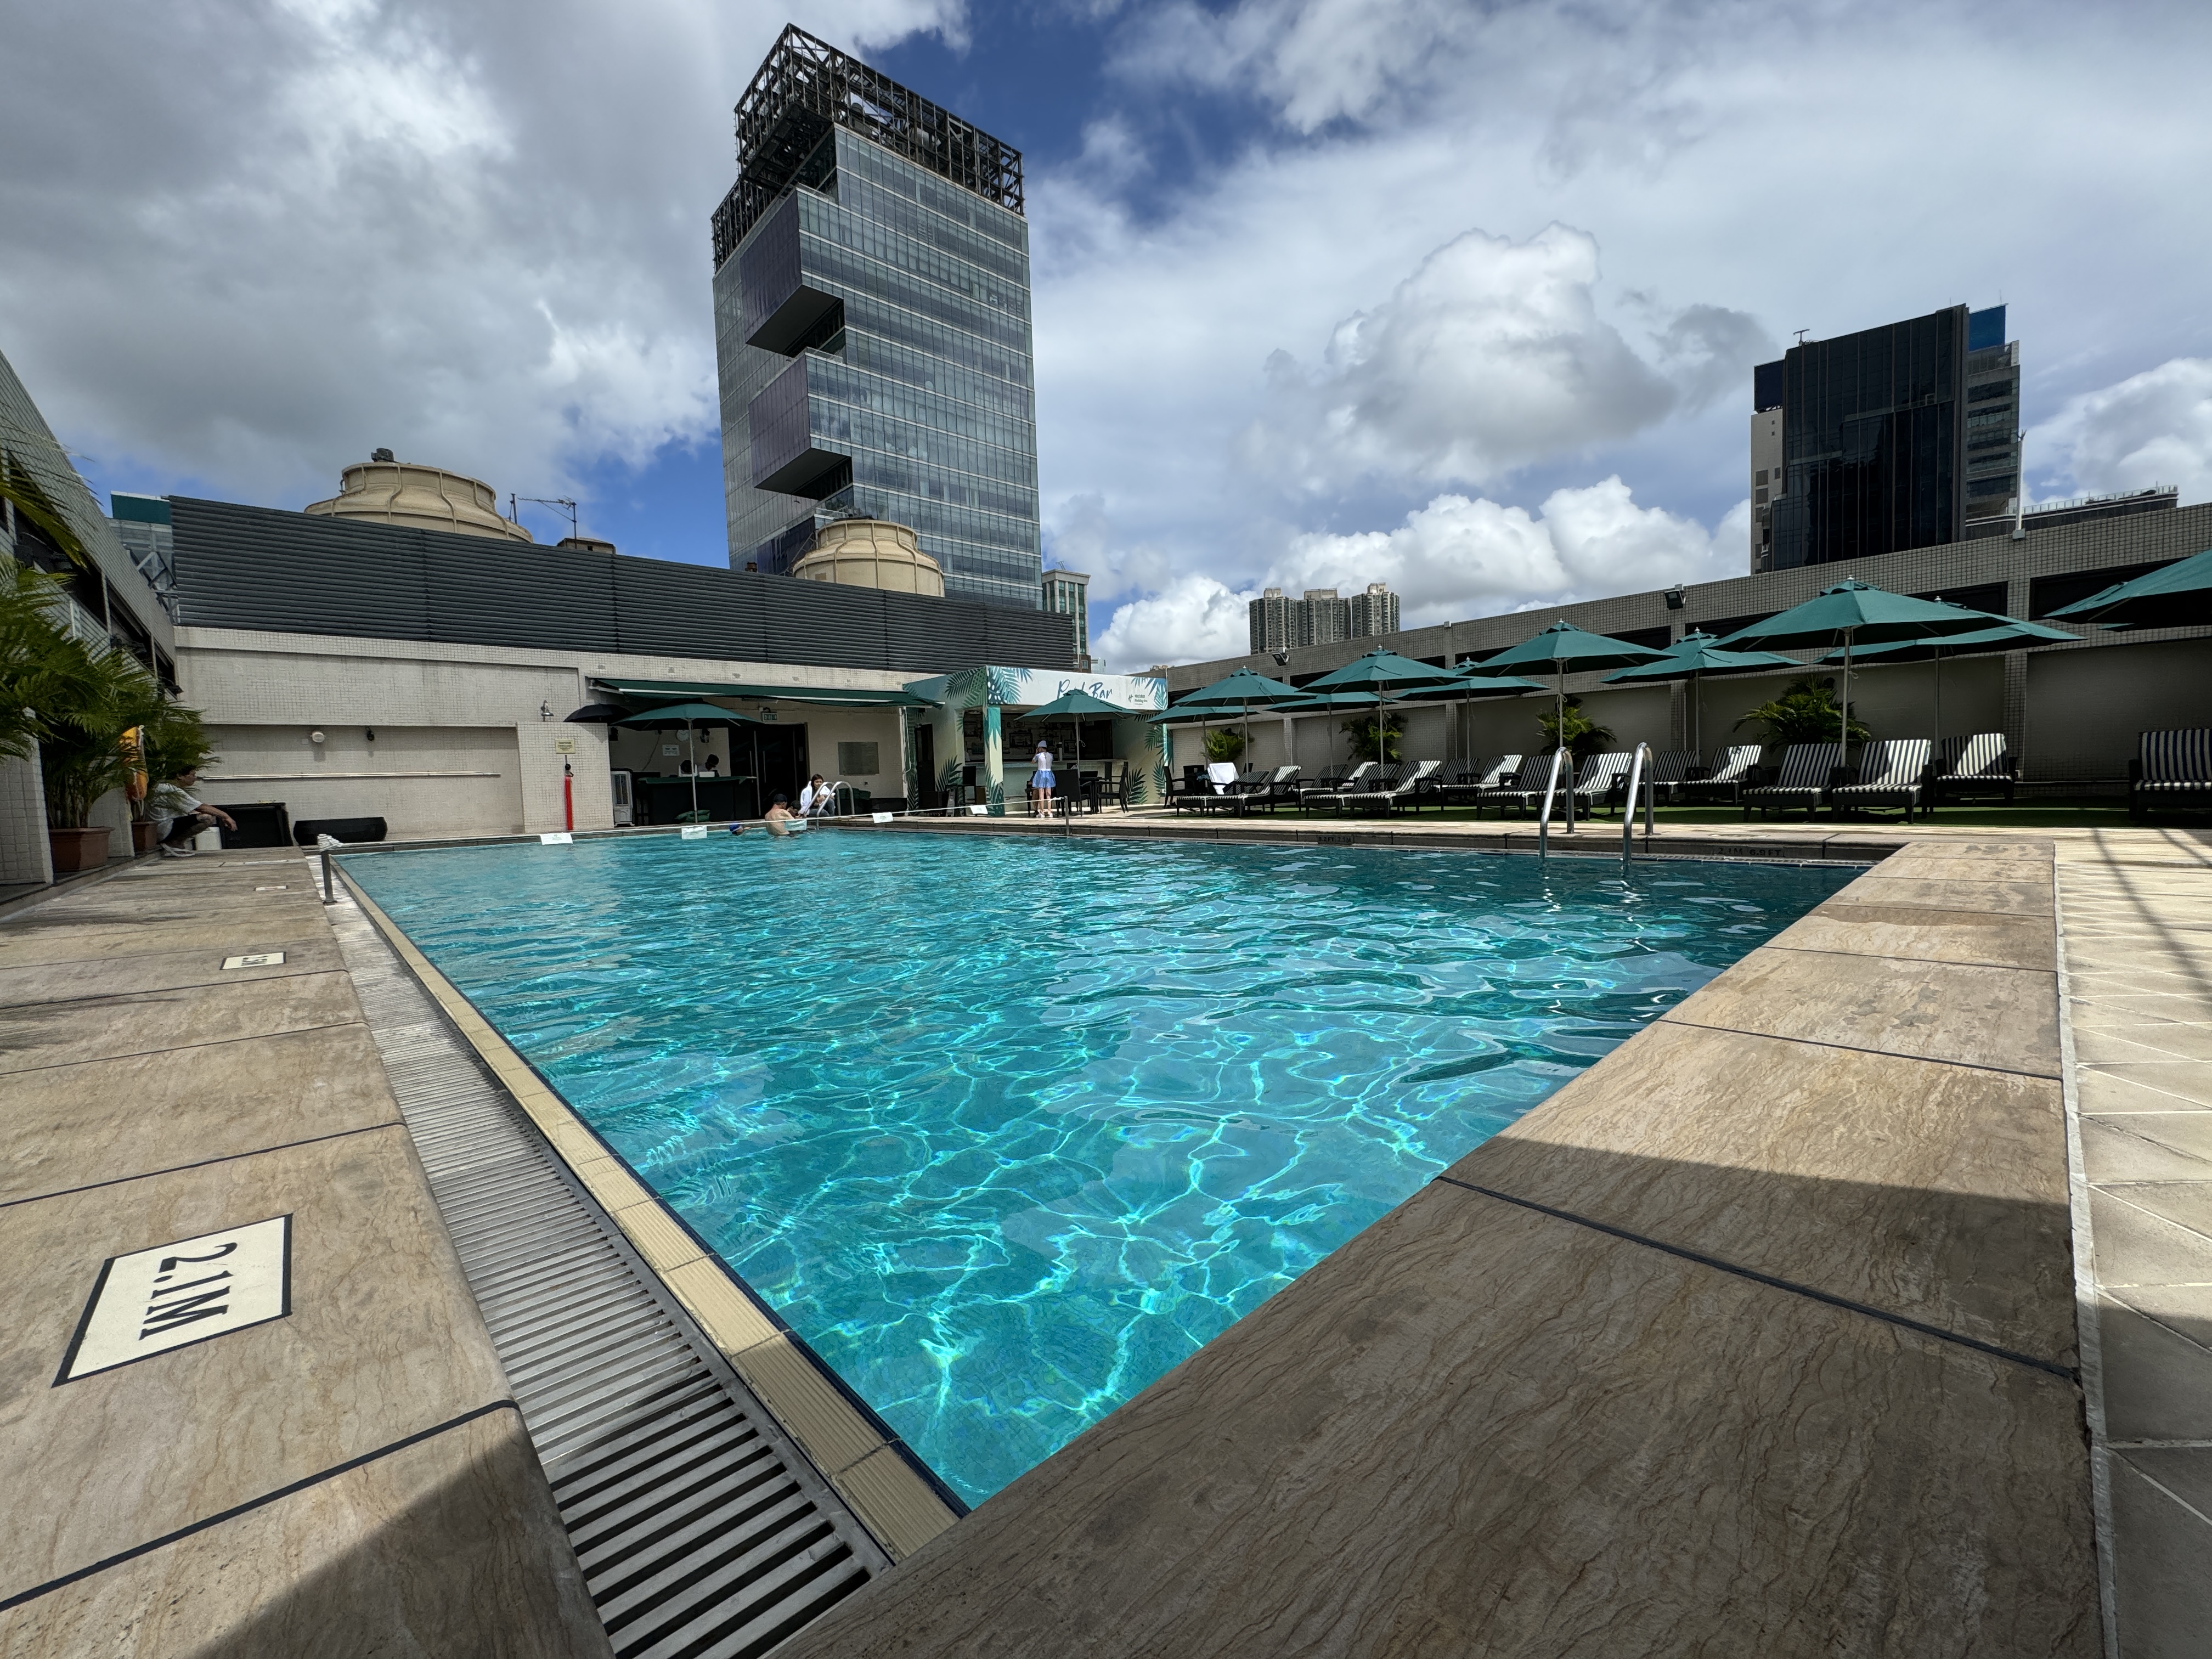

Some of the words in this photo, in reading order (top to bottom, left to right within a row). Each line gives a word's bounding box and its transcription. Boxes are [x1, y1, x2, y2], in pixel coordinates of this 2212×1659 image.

[1057, 679, 1085, 699] Pl
[1089, 682, 1113, 699] Bar
[139, 1242, 238, 1340] 2.1M
